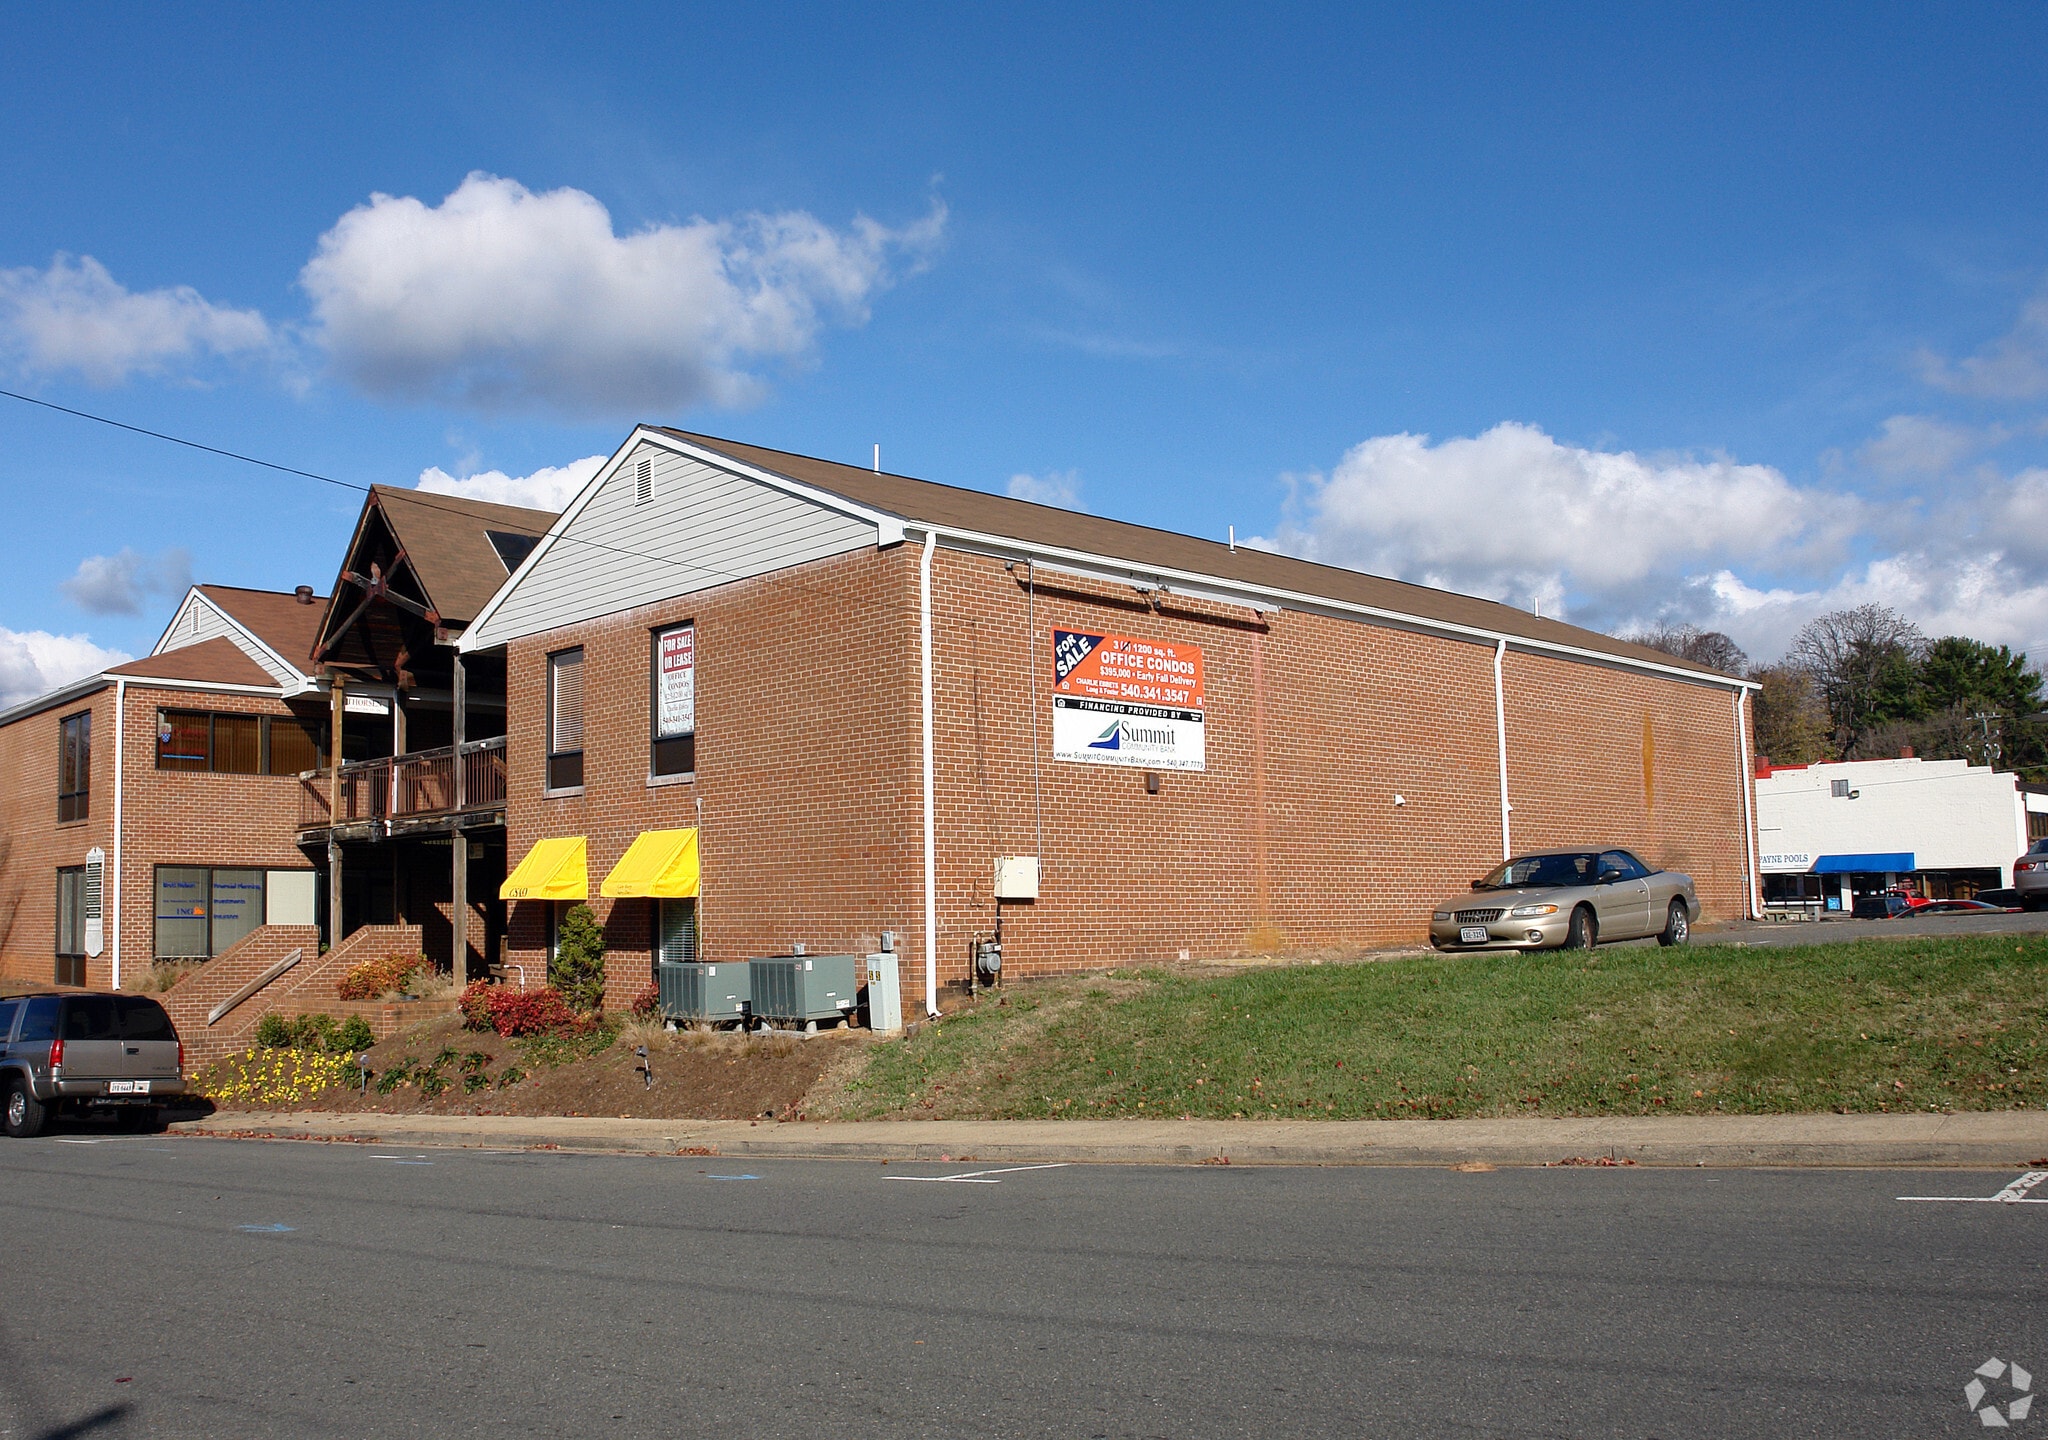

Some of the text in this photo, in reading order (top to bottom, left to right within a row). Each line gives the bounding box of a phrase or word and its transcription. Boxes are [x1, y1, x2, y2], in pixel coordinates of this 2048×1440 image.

[664, 634, 692, 652] FOR SALE
[1056, 634, 1077, 657] FOR
[1133, 643, 1153, 655] 1200
[664, 651, 692, 669] OR LEASE
[1057, 636, 1092, 677] SALE
[1101, 651, 1195, 674] OFFICE CONDOS
[1100, 666, 1197, 689] $395,000 Early Fall Delivery
[1121, 684, 1189, 703] 540.341.3547
[1079, 701, 1125, 714] FINANCING
[1128, 705, 1168, 718] PROVIDED
[1171, 711, 1181, 720] BY
[1121, 720, 1176, 745] Summit
[1759, 853, 1809, 864] PAYNE POOLS
